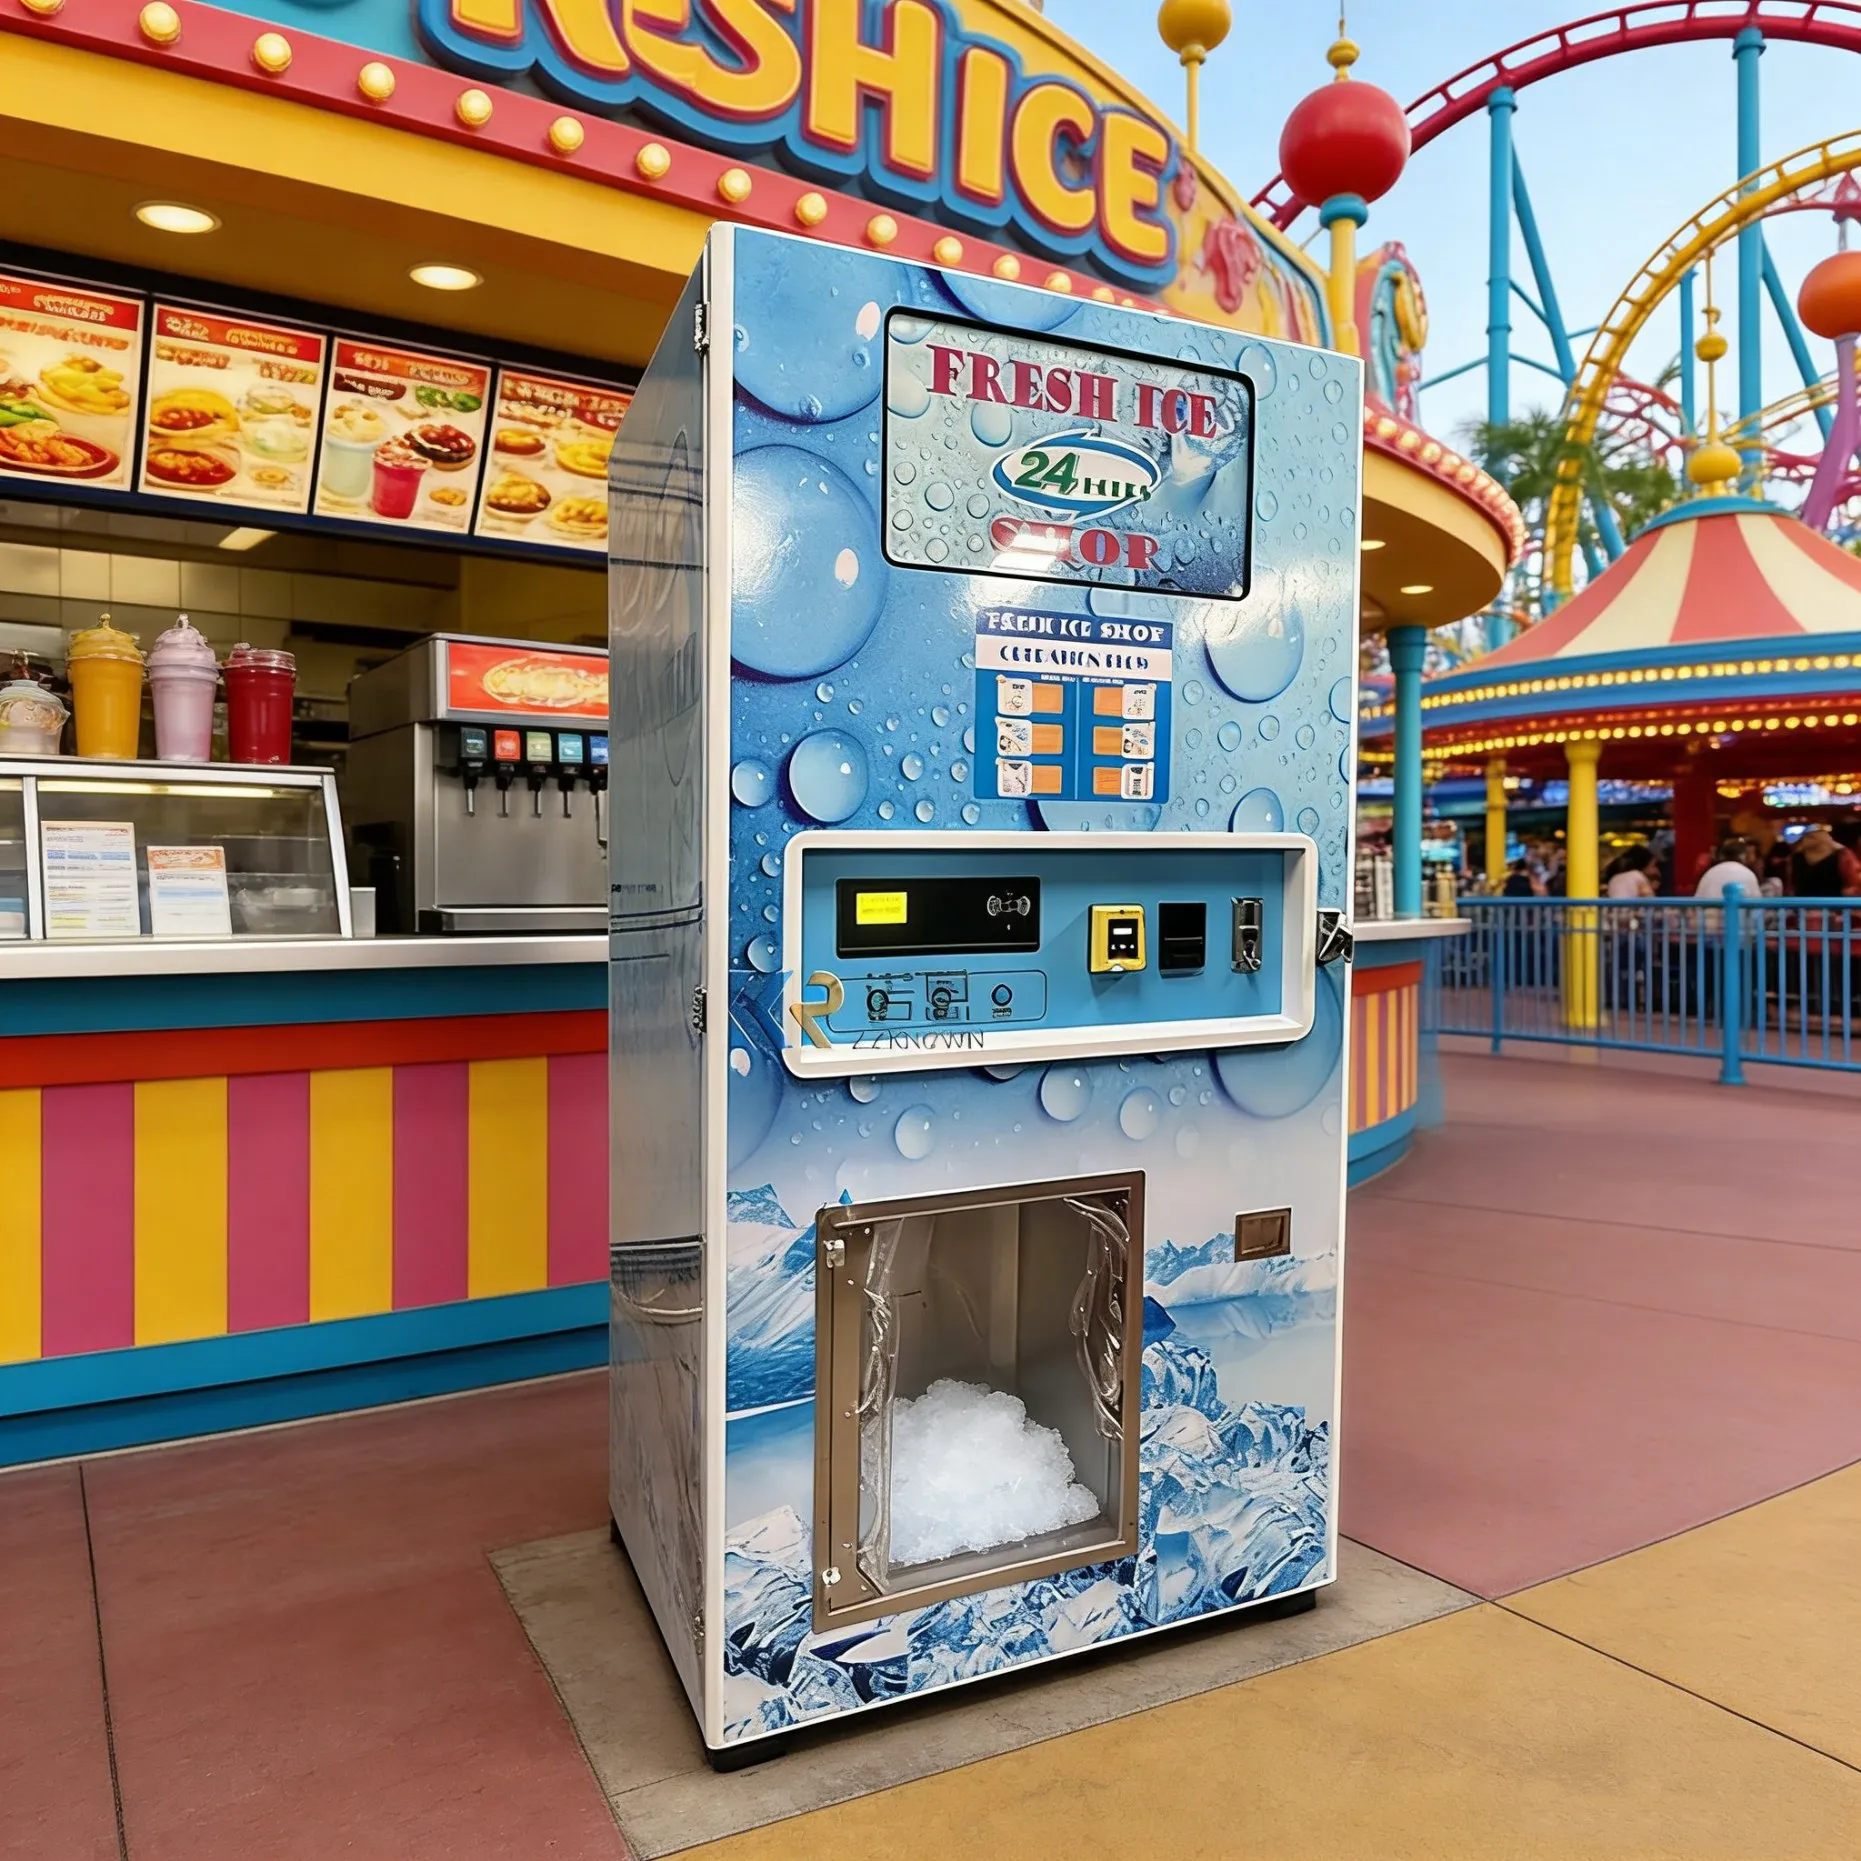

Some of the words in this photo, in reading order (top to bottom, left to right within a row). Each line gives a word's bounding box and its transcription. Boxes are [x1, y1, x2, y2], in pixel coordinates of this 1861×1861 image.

[926, 344, 1119, 423] FRESH
[1134, 382, 1217, 439] ICE
[1014, 450, 1080, 496] 24
